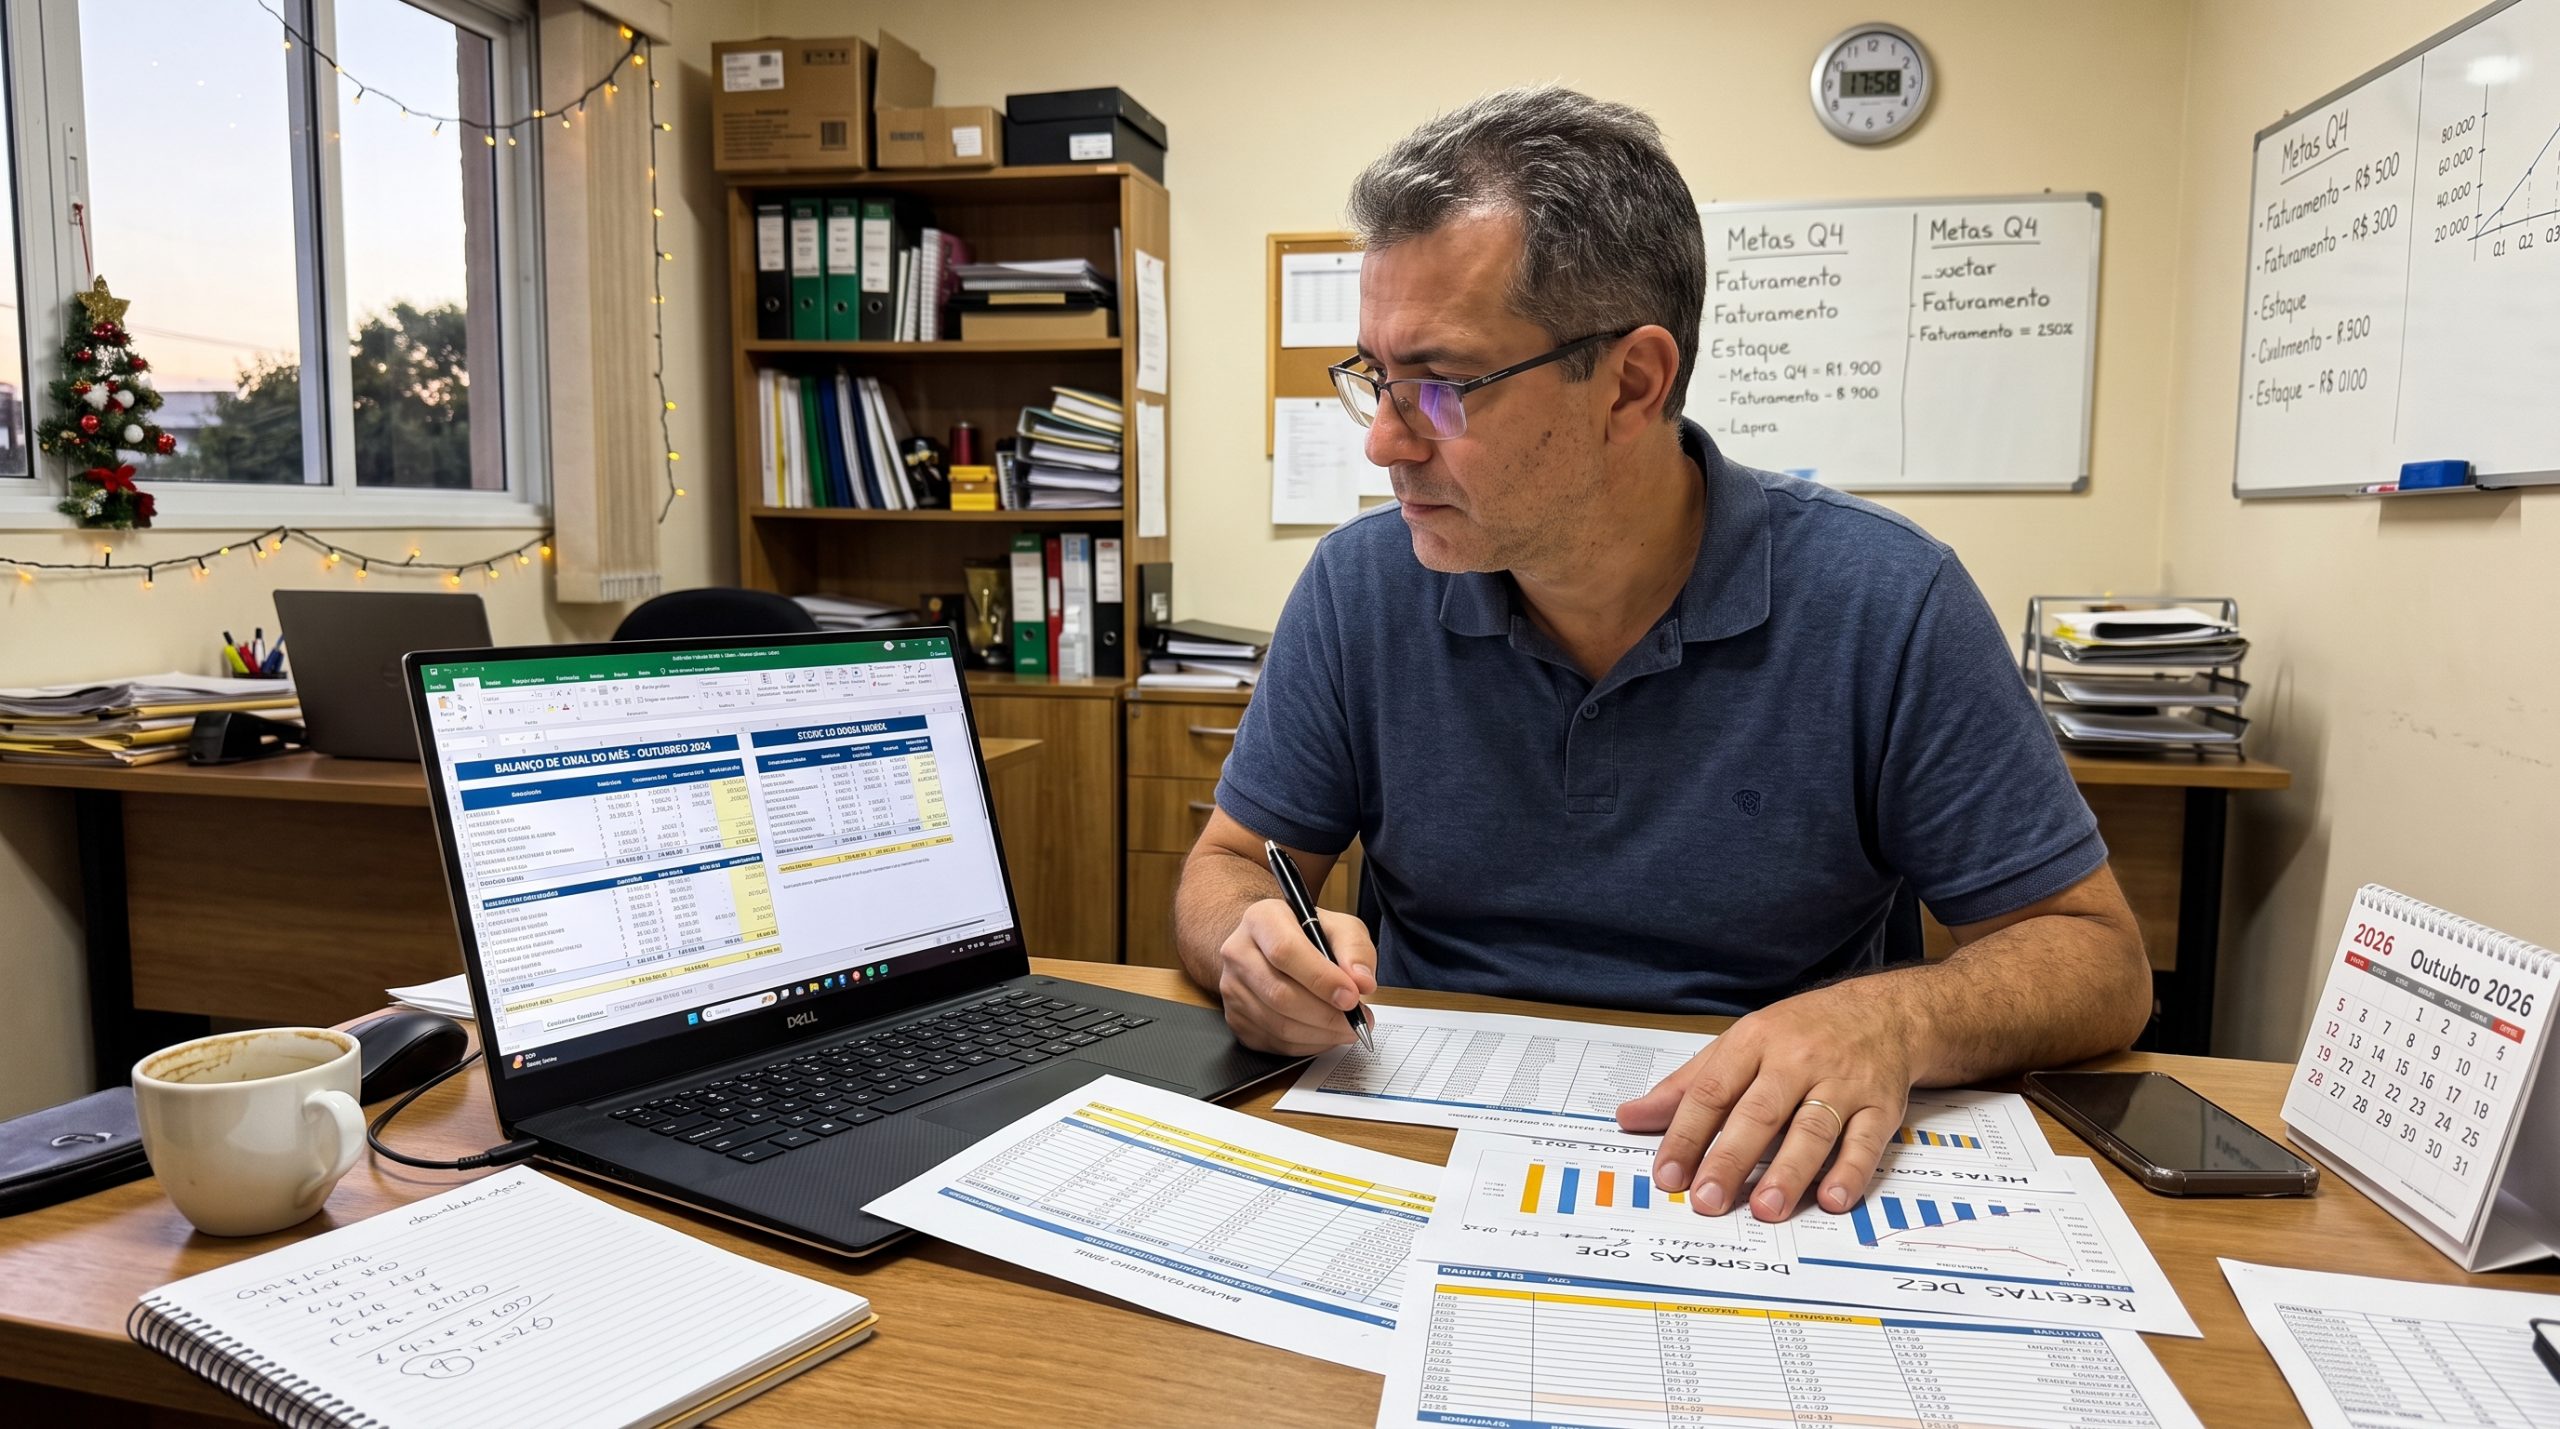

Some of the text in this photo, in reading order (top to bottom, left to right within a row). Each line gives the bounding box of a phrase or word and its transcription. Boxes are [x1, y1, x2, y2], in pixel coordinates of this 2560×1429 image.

[1867, 40, 1879, 52] 12
[1903, 56, 1911, 69] 2
[1851, 71, 1899, 95] 17:58
[2282, 108, 2349, 174] Metas Q4
[2441, 115, 2475, 143] 80.000
[2439, 146, 2473, 176] 60.000
[2267, 176, 2339, 232] Faturamento
[2355, 164, 2370, 192] R$
[2375, 152, 2400, 184] 500
[2436, 181, 2471, 209] 40.000
[1727, 223, 1844, 252] Metas Q4
[1930, 215, 2038, 242] Metas Q4
[2264, 225, 2336, 274] Faturamento
[2372, 204, 2398, 234] 300
[1716, 266, 1841, 292] Faturamento
[1714, 299, 1839, 325] Faturamento
[1922, 288, 2051, 313] Faturamento
[1919, 323, 2013, 343] Faturamento
[1711, 339, 1791, 362] Estaque
[1730, 367, 1778, 383] Metas
[1784, 363, 1808, 381] Q4
[1730, 388, 1819, 406] Faturamento
[494, 757, 545, 774] BALANÇO
[547, 757, 560, 769] DE
[592, 752, 607, 764] DO
[609, 748, 631, 761] MÊS
[690, 741, 711, 753] 2024
[2353, 922, 2396, 957] 2026
[2410, 948, 2481, 995] Outubro
[2483, 979, 2534, 1017] 2026
[2415, 1007, 2424, 1023] 1
[2441, 1019, 2451, 1035] 2
[2467, 1031, 2476, 1047] 3
[2336, 998, 2346, 1013] 5
[2383, 1021, 2391, 1037] 7
[2406, 1033, 2415, 1049] 8
[2431, 1045, 2441, 1061] 9
[2455, 1057, 2472, 1077] 10
[2484, 1071, 2498, 1092] 11
[2326, 1020, 2489, 1119] 12 13 14 15 16 17 18
[2316, 1044, 2331, 1062] 19
[2361, 1070, 2376, 1089] 21
[2385, 1084, 2402, 1103] 22
[2409, 1097, 2427, 1117] 23
[2434, 1112, 2452, 1132] 24
[2461, 1127, 2480, 1148] 25
[2330, 1082, 2346, 1100] 27
[2352, 1094, 2368, 1114] 28
[2376, 1108, 2392, 1128] 29
[2425, 1138, 2442, 1158] 30
[2453, 1155, 2469, 1176] 31
[1574, 1245, 1791, 1277] DESPESAS ODE
[1891, 1277, 1966, 1296] DEZ
